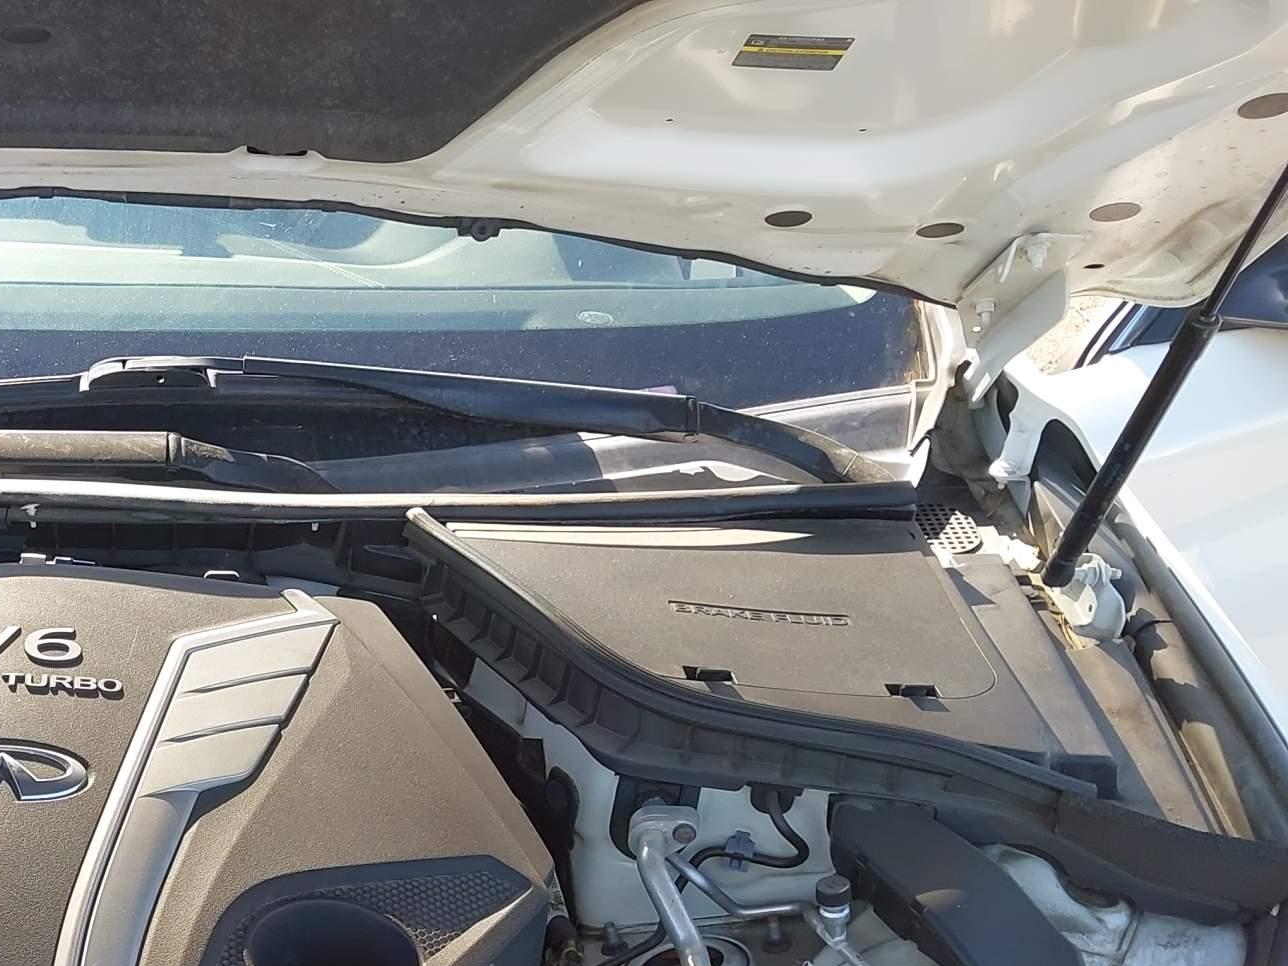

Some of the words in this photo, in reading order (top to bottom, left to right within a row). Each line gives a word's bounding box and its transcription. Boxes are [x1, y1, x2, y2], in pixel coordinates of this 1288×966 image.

[669, 602, 765, 621] BRAKE
[770, 611, 853, 627] FLUID
[1, 672, 124, 700] TURBO
